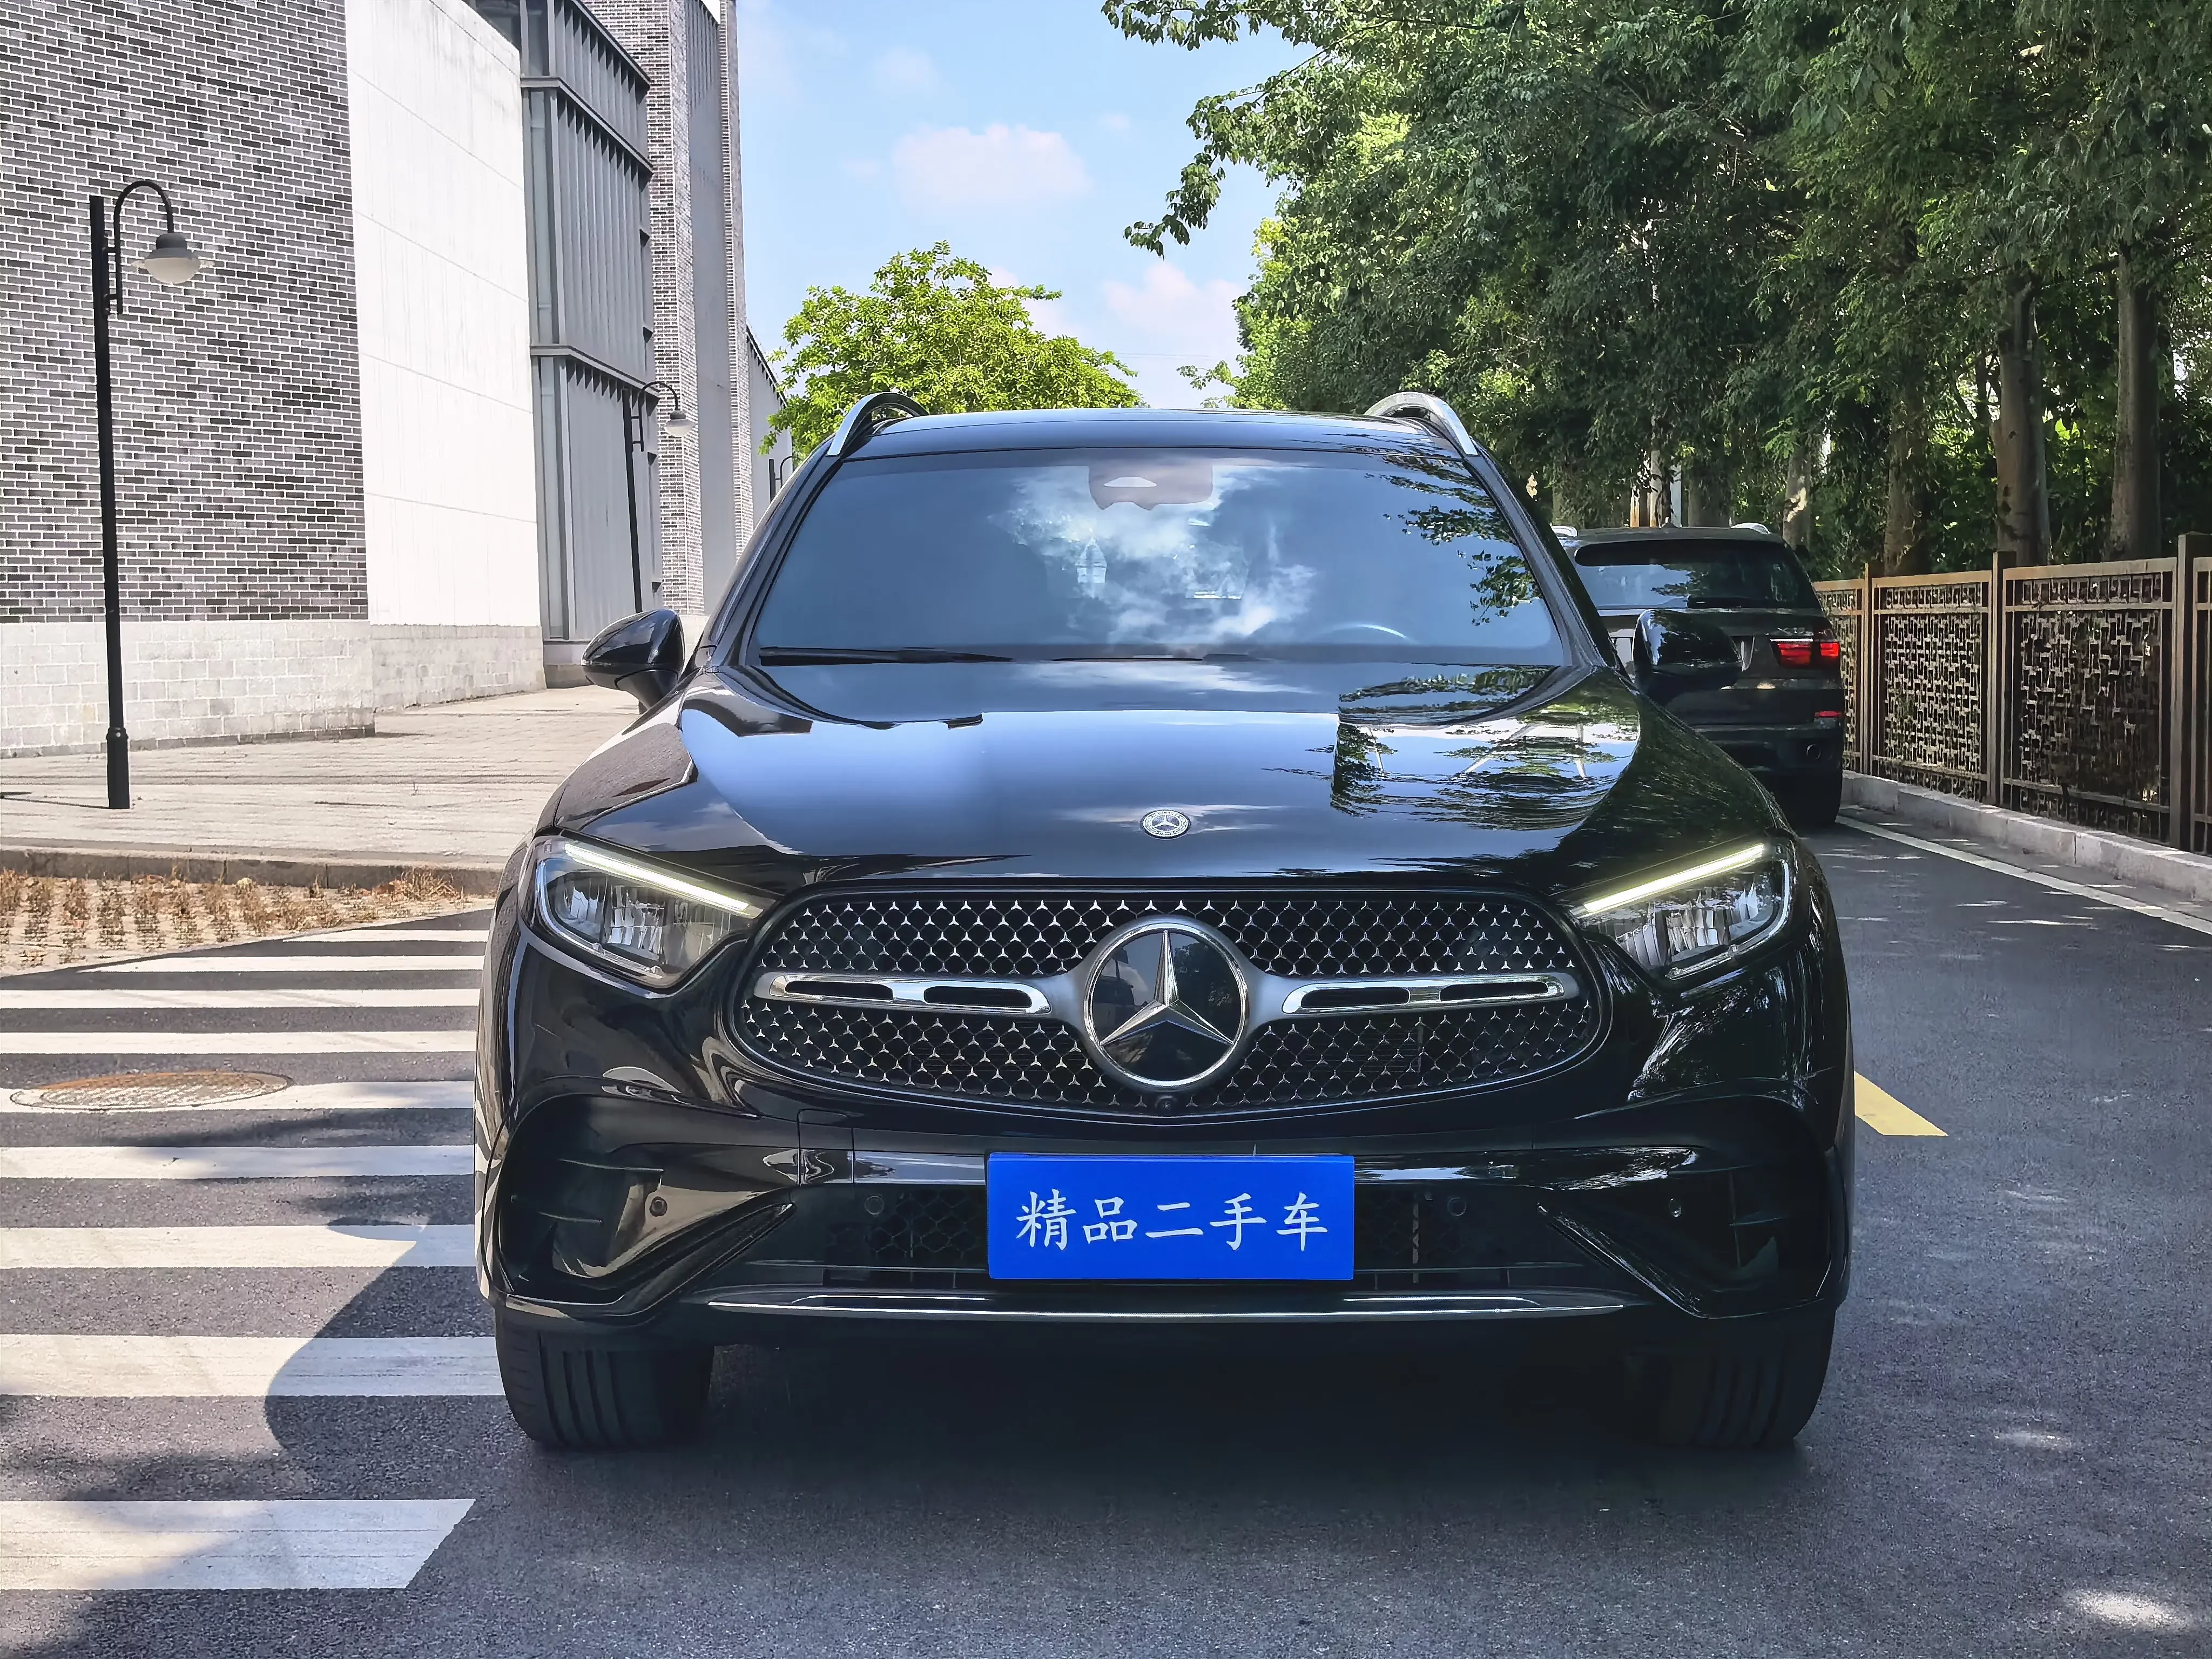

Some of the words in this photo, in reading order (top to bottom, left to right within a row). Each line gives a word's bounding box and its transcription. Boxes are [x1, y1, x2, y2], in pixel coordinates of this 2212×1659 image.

[1016, 1189, 1327, 1251] 精品二手车
